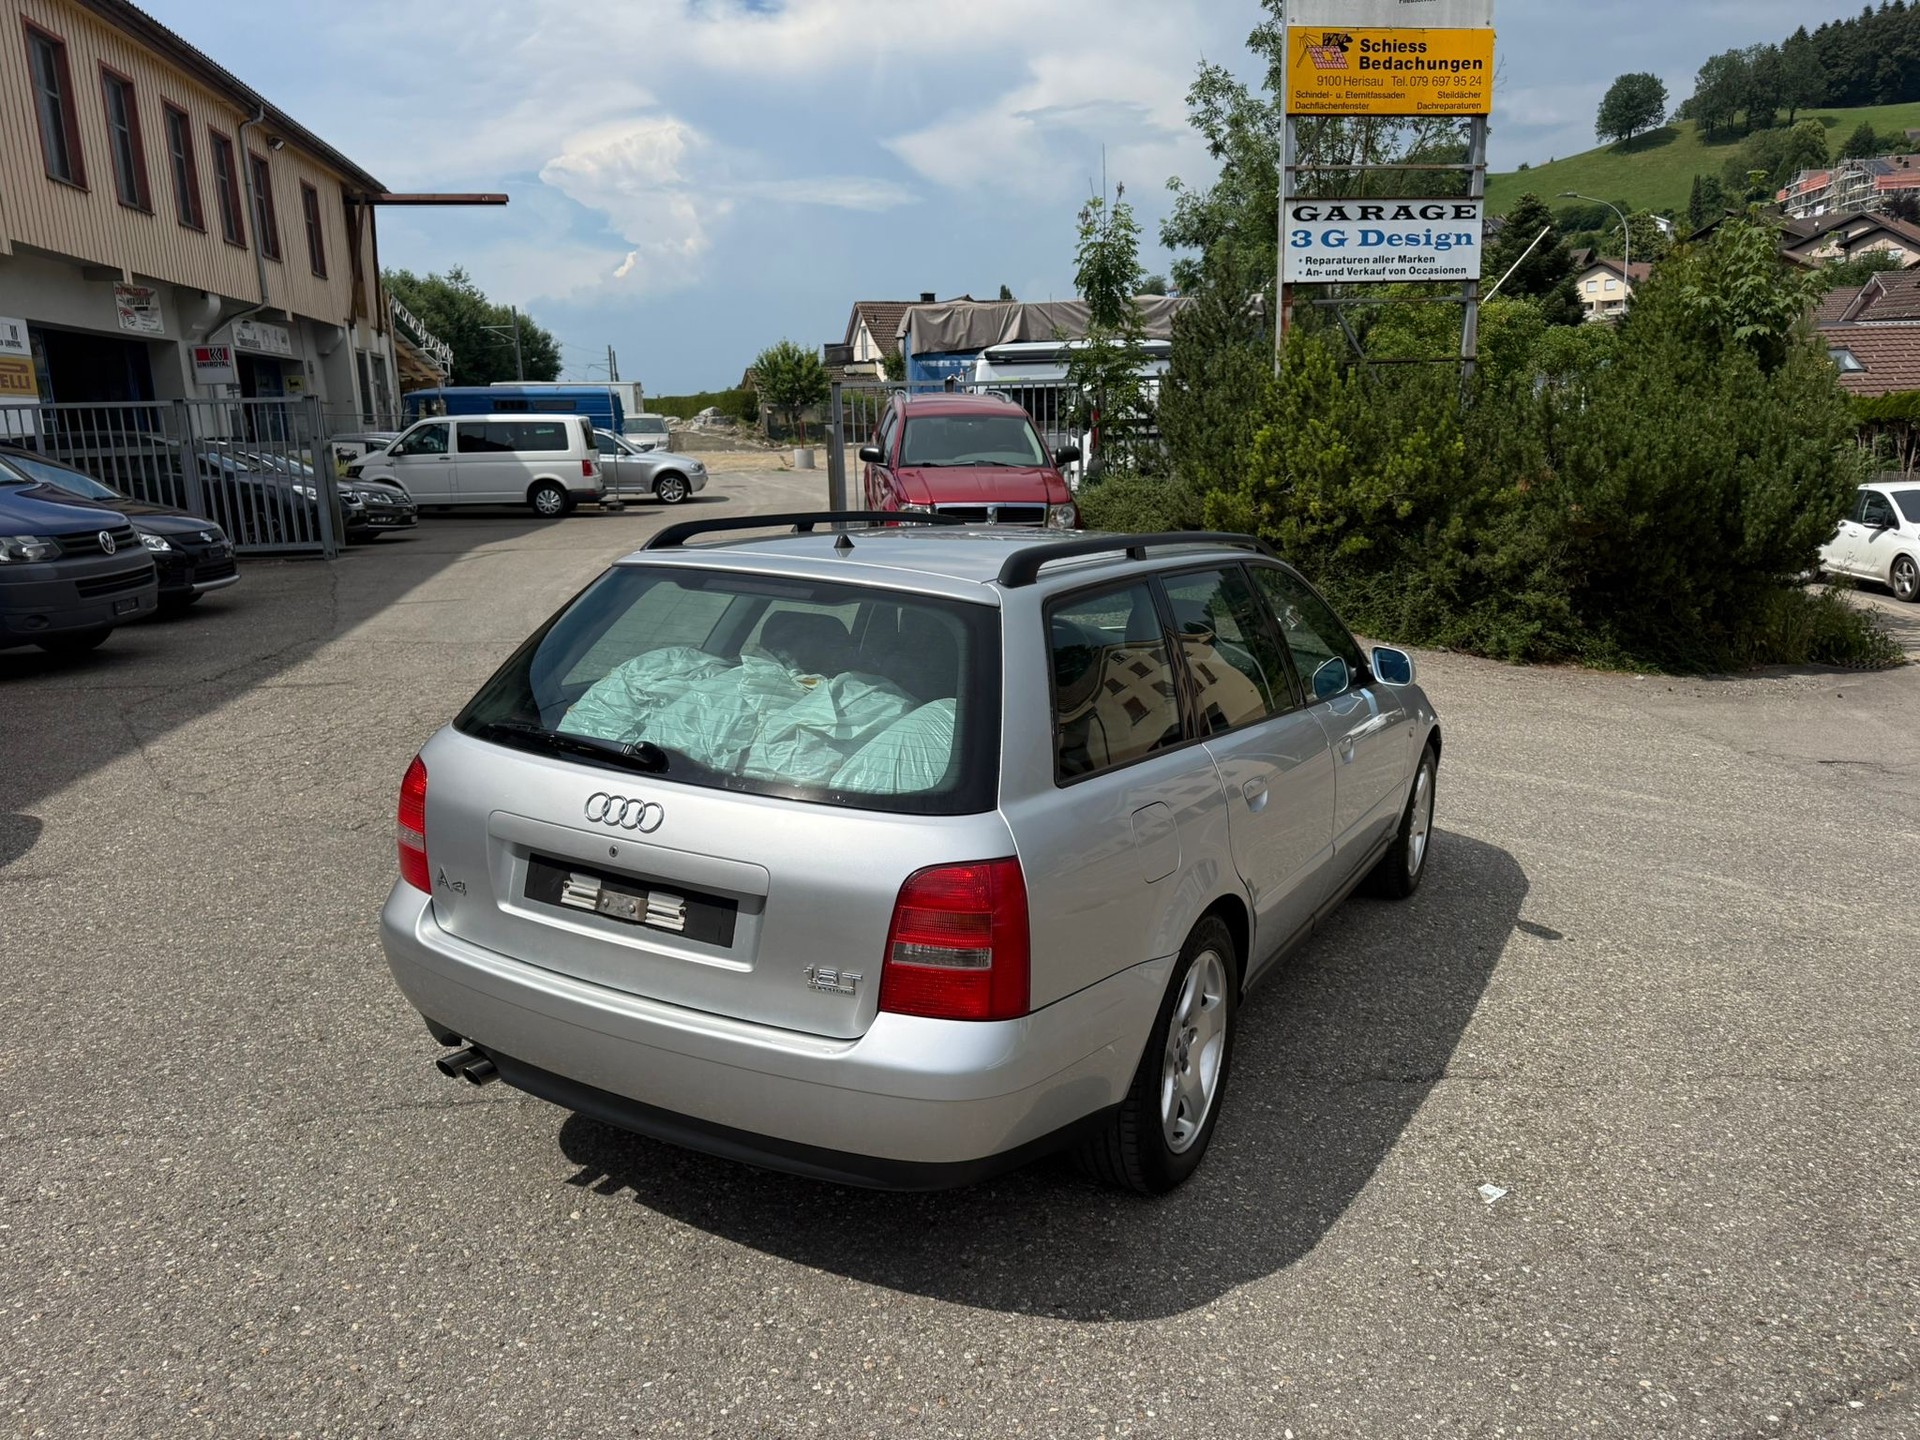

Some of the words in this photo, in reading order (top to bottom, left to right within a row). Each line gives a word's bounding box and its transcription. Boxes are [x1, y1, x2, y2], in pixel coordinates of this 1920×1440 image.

[1359, 38, 1427, 53] Schiess
[1359, 56, 1483, 72] Bedachungen
[1316, 75, 1342, 87] 9100
[1343, 75, 1384, 87] Herisau
[1391, 75, 1408, 87] Tel.
[1410, 75, 1429, 87] 079
[1432, 75, 1451, 87] 697
[1453, 75, 1467, 87] 95
[1469, 75, 1482, 87] 24
[1295, 90, 1333, 99] Schindel-
[1336, 91, 1343, 99] u.
[1345, 90, 1406, 99] Eternitfassaden
[1437, 90, 1482, 99] Steildächer
[1295, 101, 1370, 110] Dachflächenfenster
[1417, 101, 1482, 111] Dachreparaturen
[1292, 204, 1476, 222] GARAGE
[1290, 229, 1313, 248] 3
[1320, 229, 1350, 248] G
[1357, 228, 1475, 251] Design
[1305, 255, 1370, 267] Reparaturen
[1372, 255, 1396, 264] aller
[1397, 254, 1436, 264] Marken
[1305, 267, 1323, 277] An-
[1325, 267, 1344, 277] und
[1346, 266, 1386, 276] Verkauf
[1388, 266, 1406, 276] von
[1408, 266, 1467, 275] Occasionen
[196, 361, 231, 369] UNIROYAL
[436, 865, 467, 896] A4
